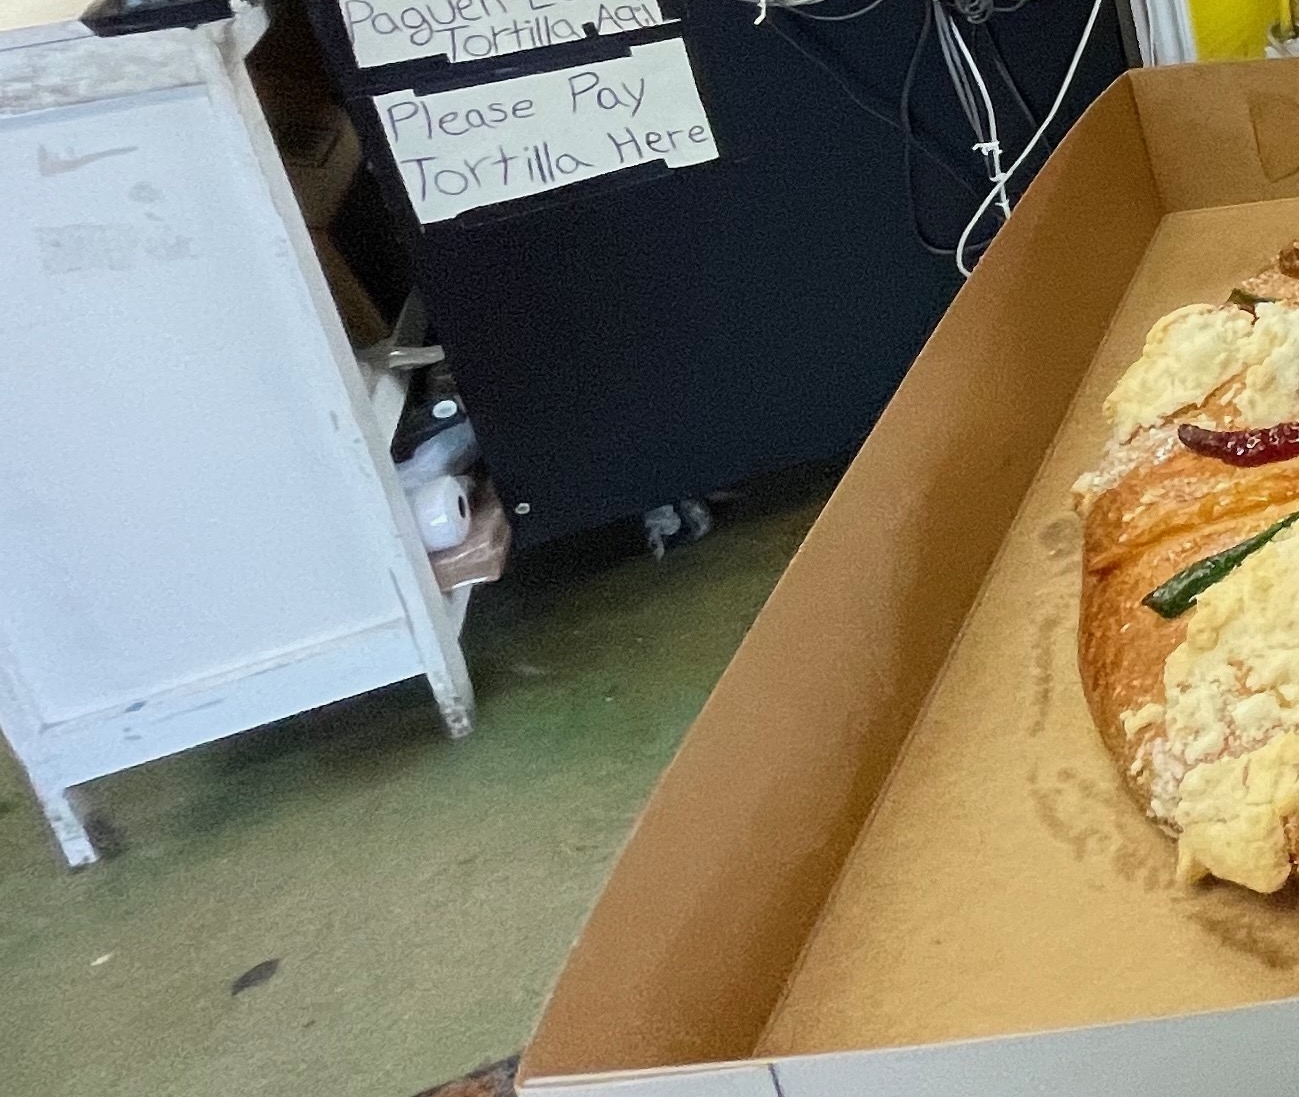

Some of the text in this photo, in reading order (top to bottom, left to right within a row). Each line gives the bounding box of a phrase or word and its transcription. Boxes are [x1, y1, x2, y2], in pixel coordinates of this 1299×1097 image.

[432, 15, 582, 62] Tortilla
[387, 71, 645, 143] Please Pay
[400, 123, 709, 202] Tortilla Here
